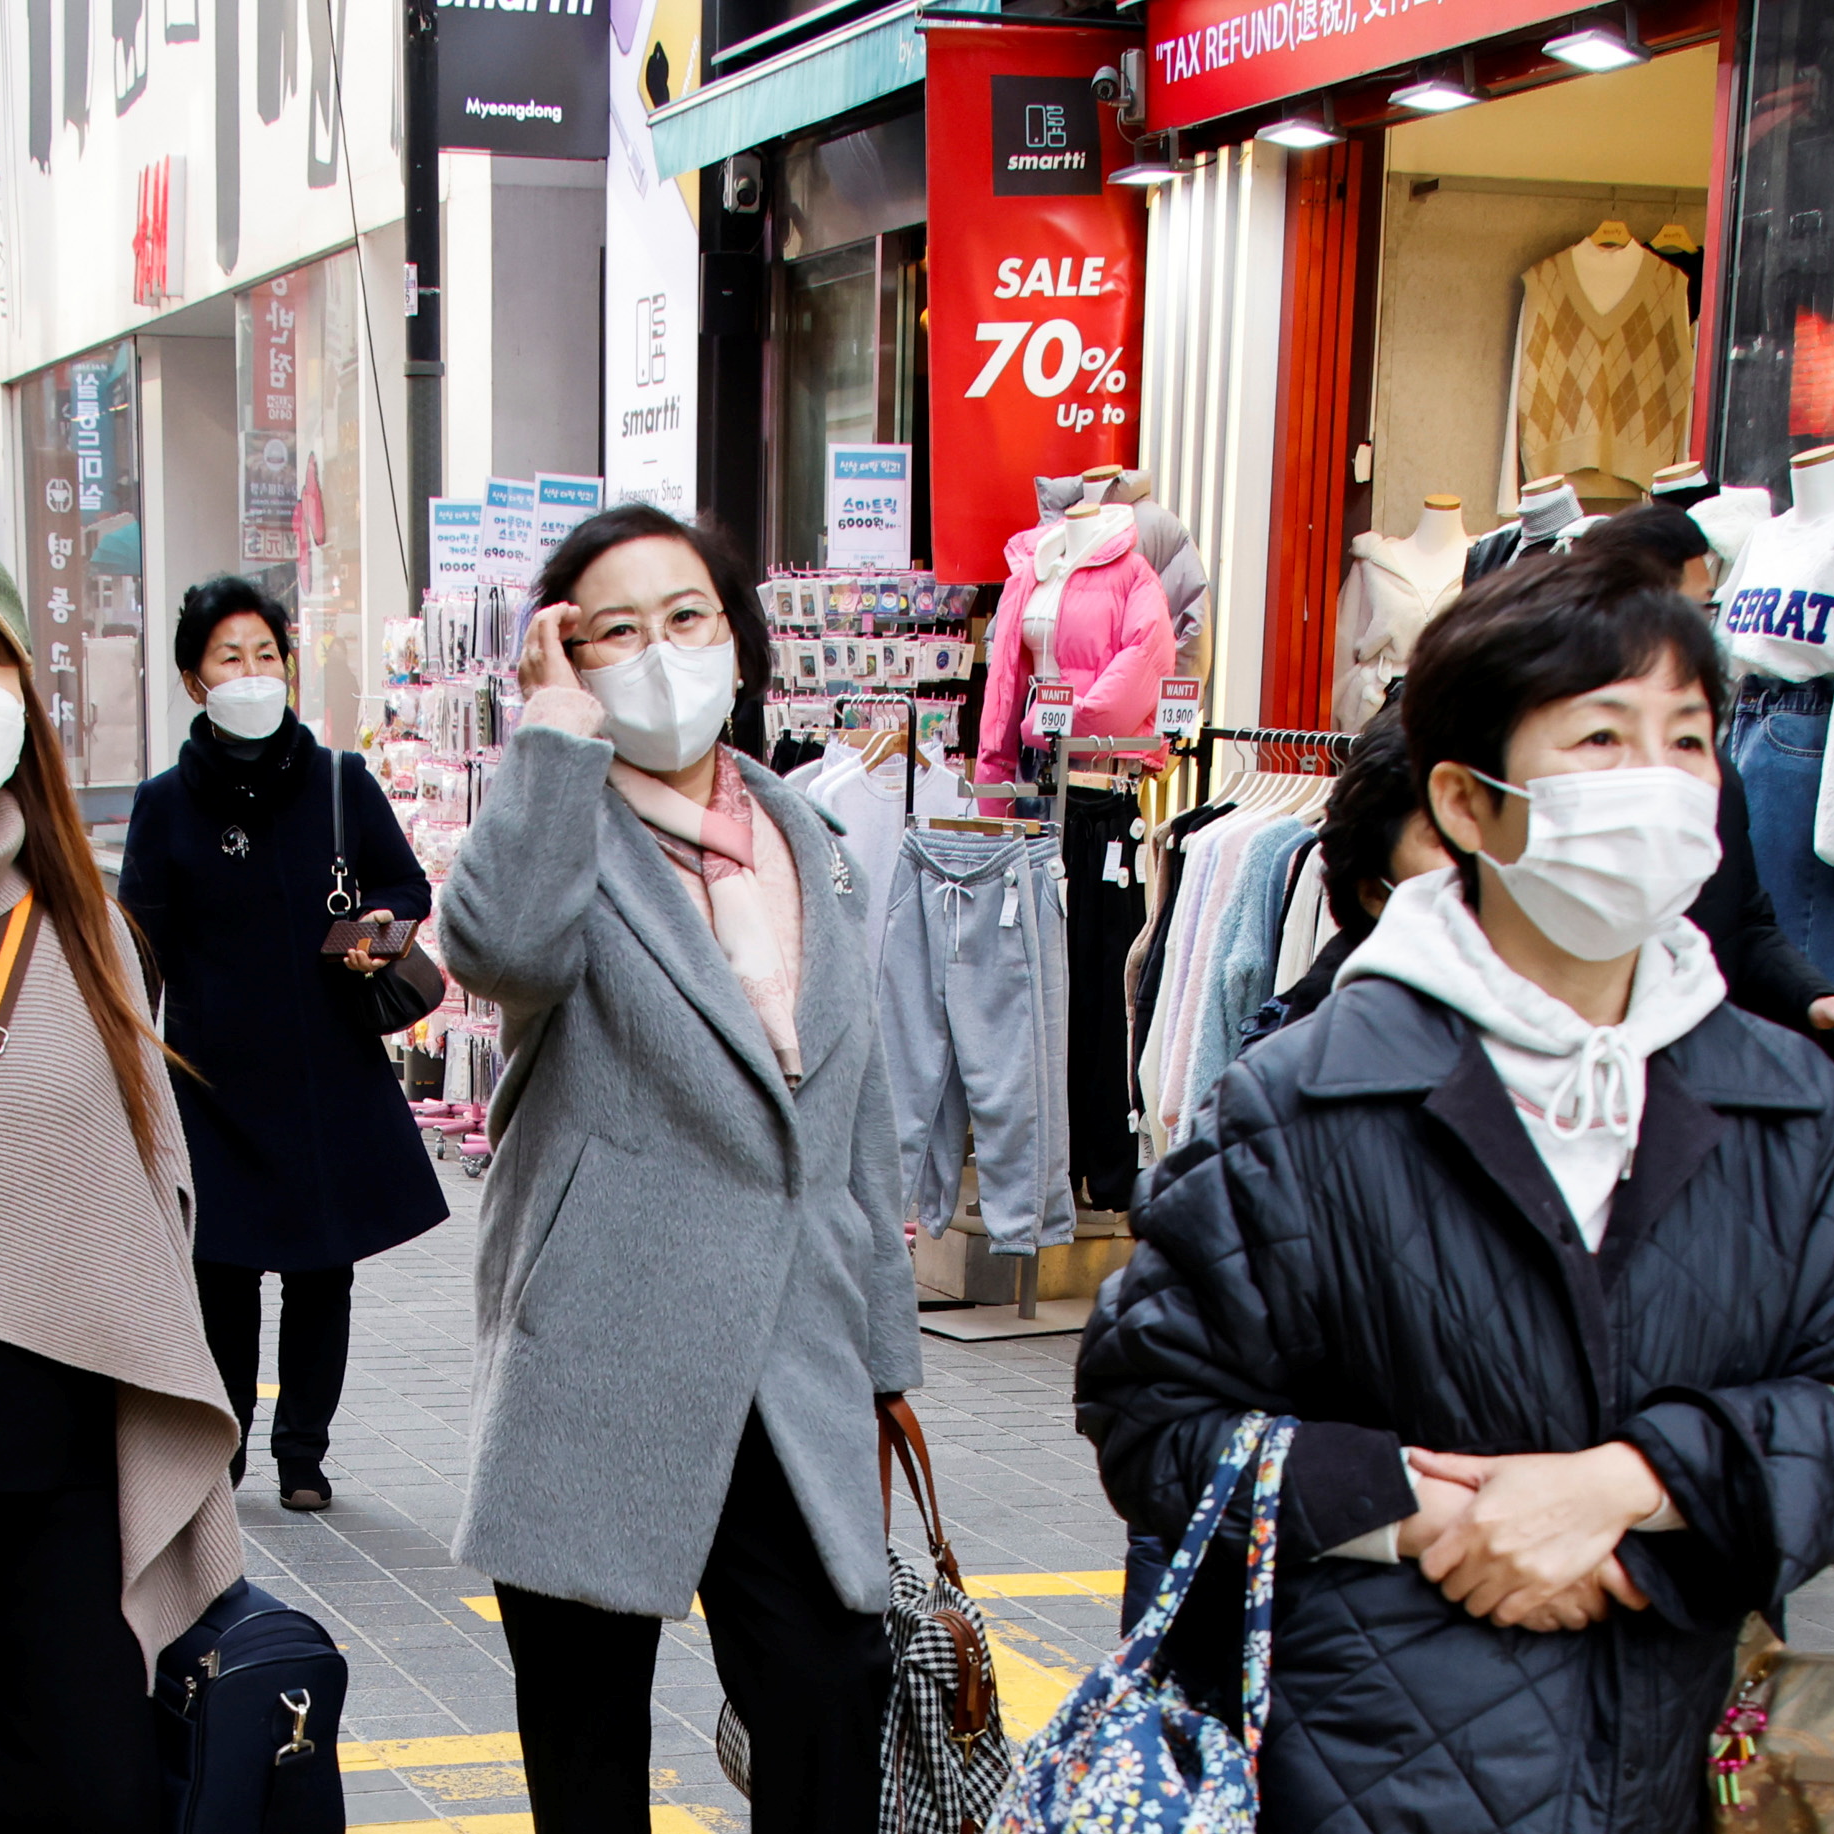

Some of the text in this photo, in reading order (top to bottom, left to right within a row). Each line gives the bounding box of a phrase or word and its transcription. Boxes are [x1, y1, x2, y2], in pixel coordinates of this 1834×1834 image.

[465, 97, 563, 123] Myeongdong
[1007, 151, 1087, 171] smartti
[993, 256, 1106, 300] SALE
[964, 318, 1126, 399] 70%
[622, 396, 681, 438] smartti
[1056, 403, 1126, 433] Up to
[661, 477, 683, 503] Shop
[842, 496, 898, 514] 스마트링
[838, 517, 884, 532] 6000원
[1041, 689, 1071, 701] WANTT
[1166, 684, 1195, 697] WANTT
[1041, 711, 1067, 727] 6900
[1162, 708, 1194, 725] 13,900
